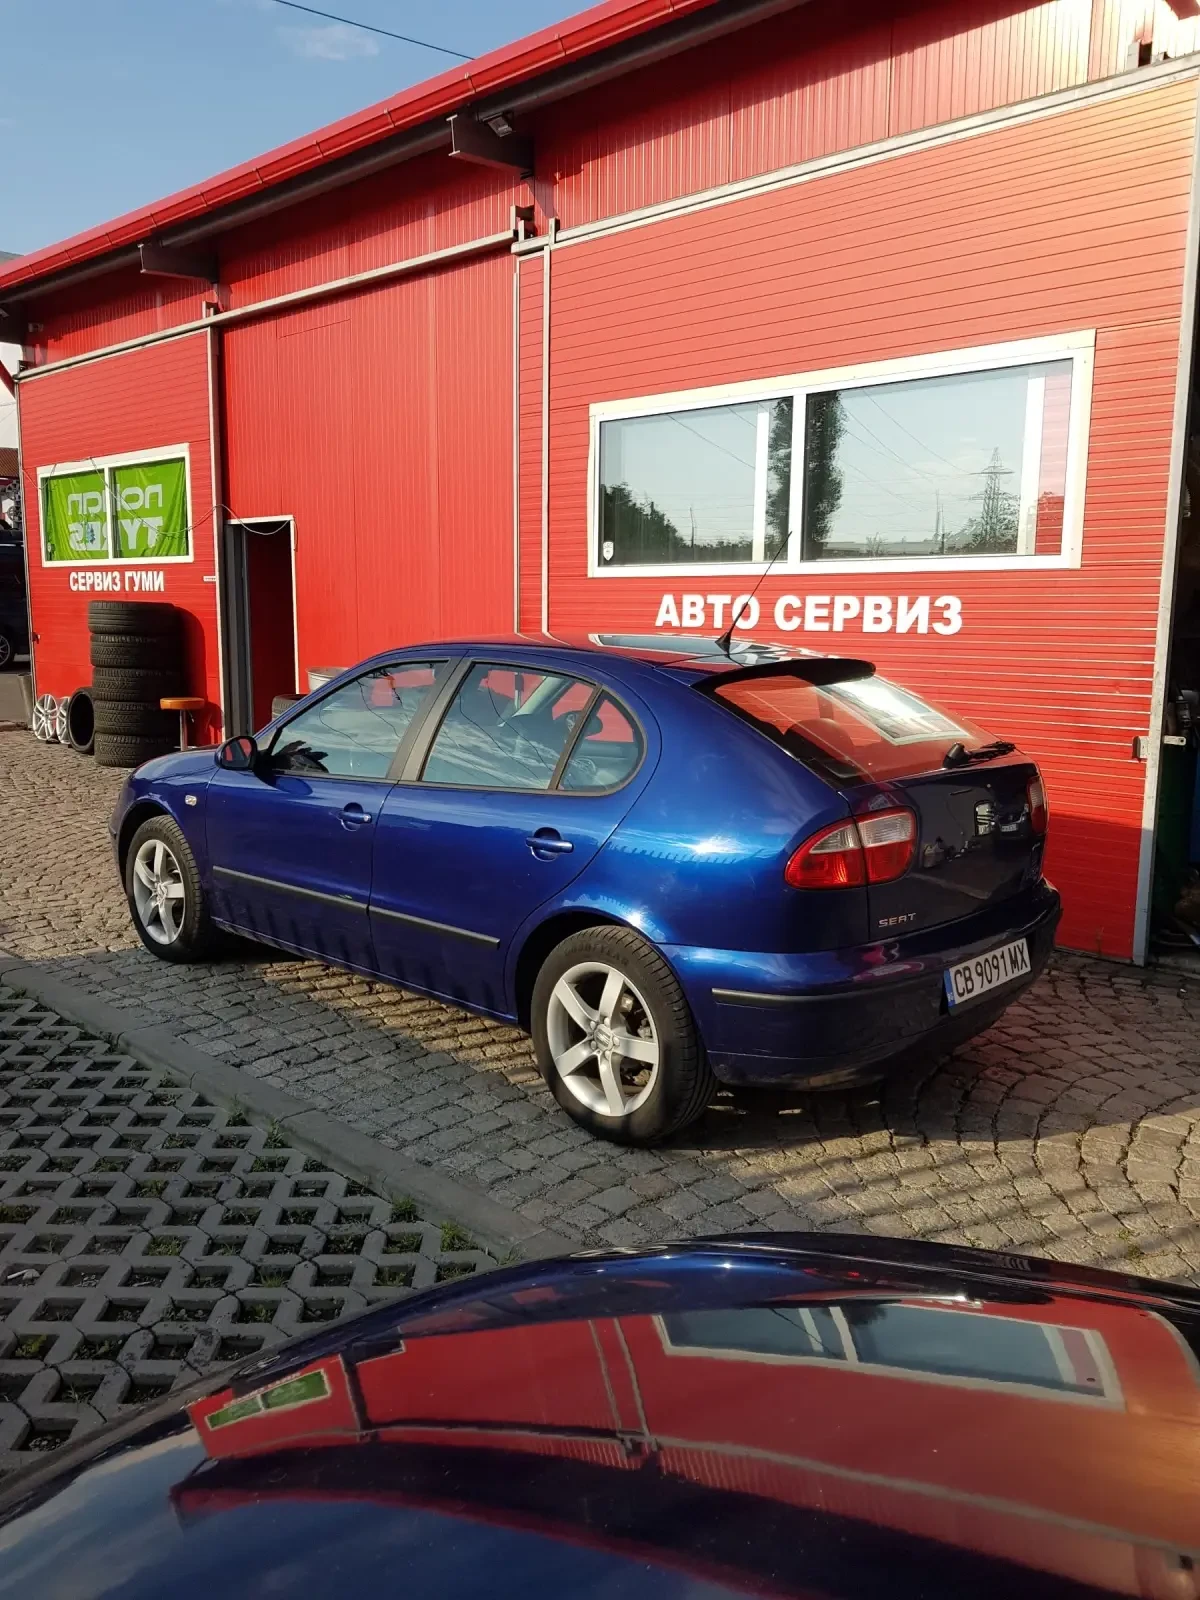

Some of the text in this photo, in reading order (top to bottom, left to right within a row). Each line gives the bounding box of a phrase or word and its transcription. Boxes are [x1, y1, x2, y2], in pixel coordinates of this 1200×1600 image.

[69, 570, 165, 592] СЕРВИЗ ГУМИ
[655, 594, 963, 635] АВТО СЕРВИЗ
[878, 912, 917, 928] SEAT
[954, 942, 1028, 998] CB 9091 MX
